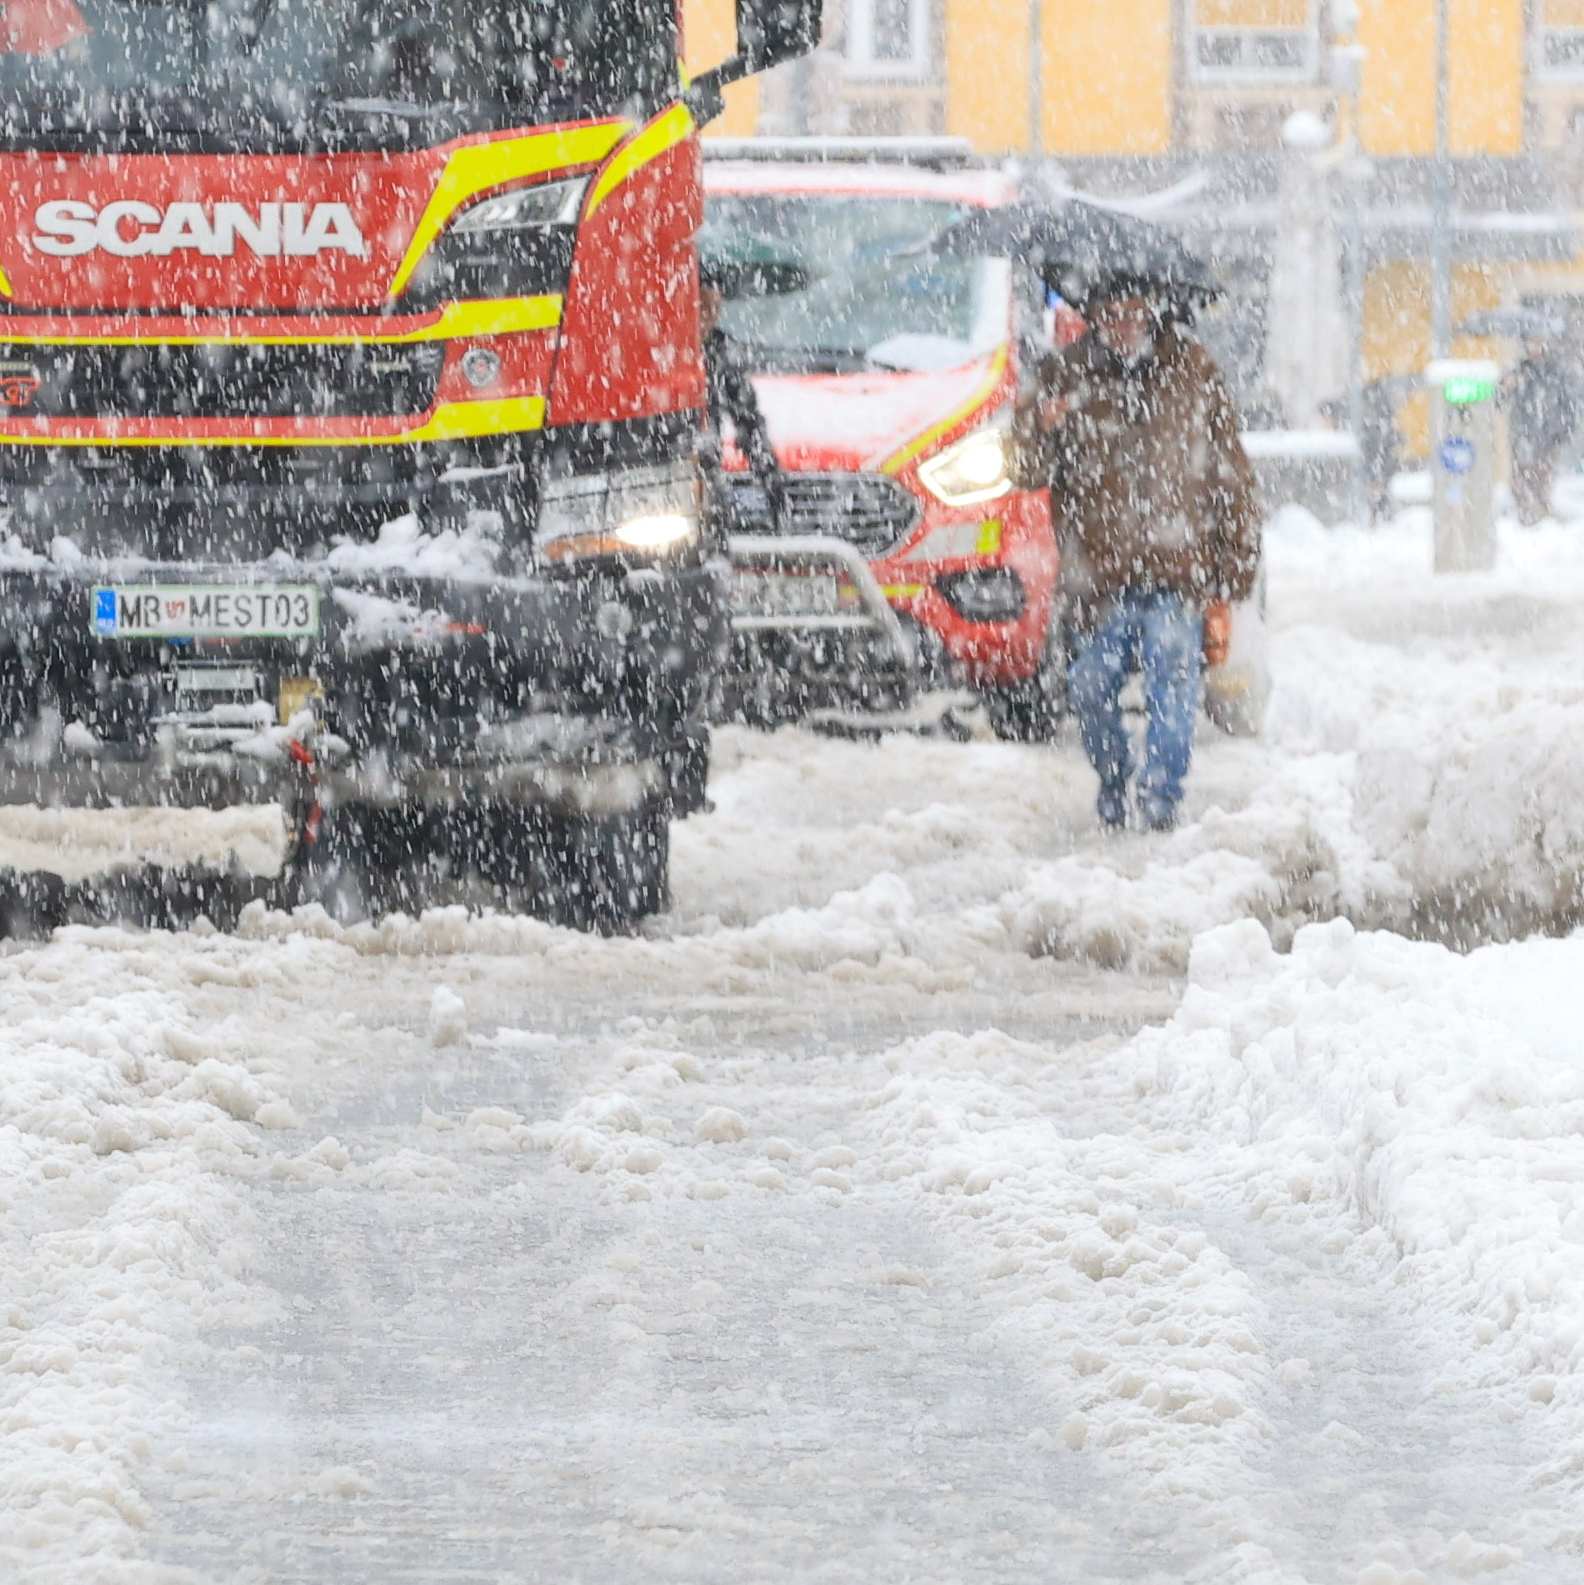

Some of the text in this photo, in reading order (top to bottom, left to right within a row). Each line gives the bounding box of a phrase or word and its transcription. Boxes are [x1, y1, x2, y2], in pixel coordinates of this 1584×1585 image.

[31, 199, 366, 257] SCANIA
[118, 593, 309, 628] MB MEST03
